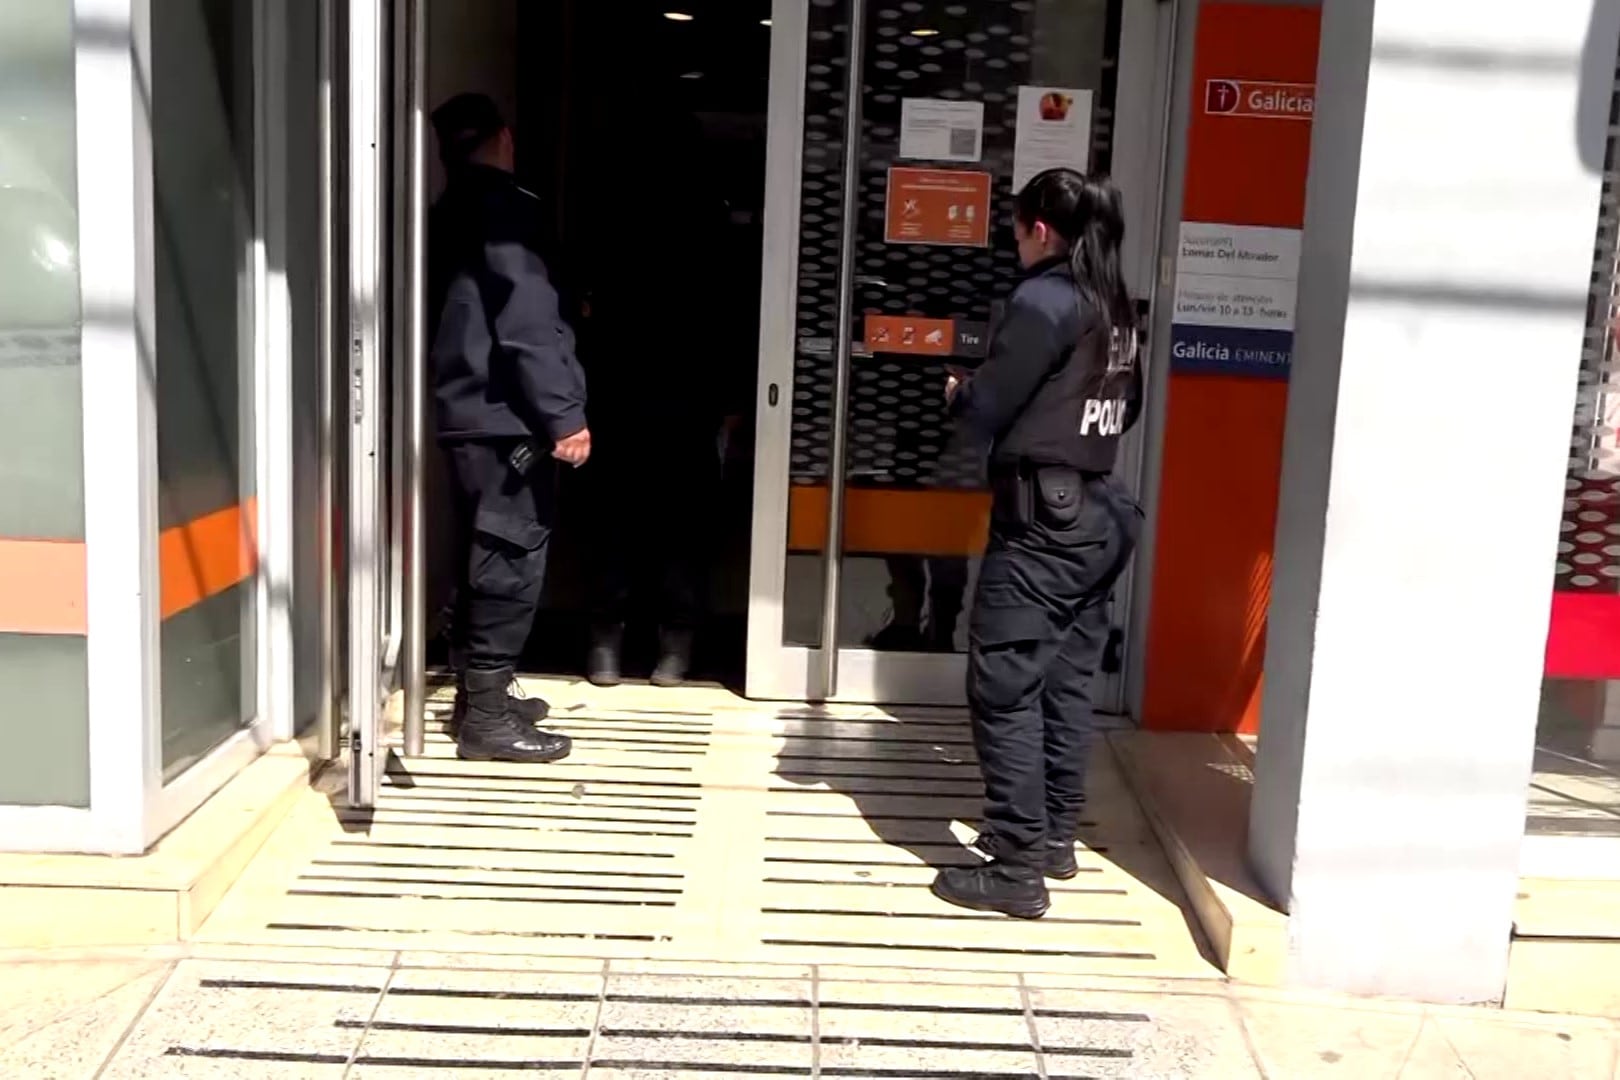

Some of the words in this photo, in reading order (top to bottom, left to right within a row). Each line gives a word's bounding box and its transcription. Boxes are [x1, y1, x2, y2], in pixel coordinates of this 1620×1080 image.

[1248, 90, 1313, 112] Galicia
[1182, 248, 1215, 259] Lomas
[1217, 249, 1236, 260] Del
[1237, 252, 1279, 262] Mirador
[960, 333, 980, 345] Tire
[1172, 341, 1230, 361] Galicia
